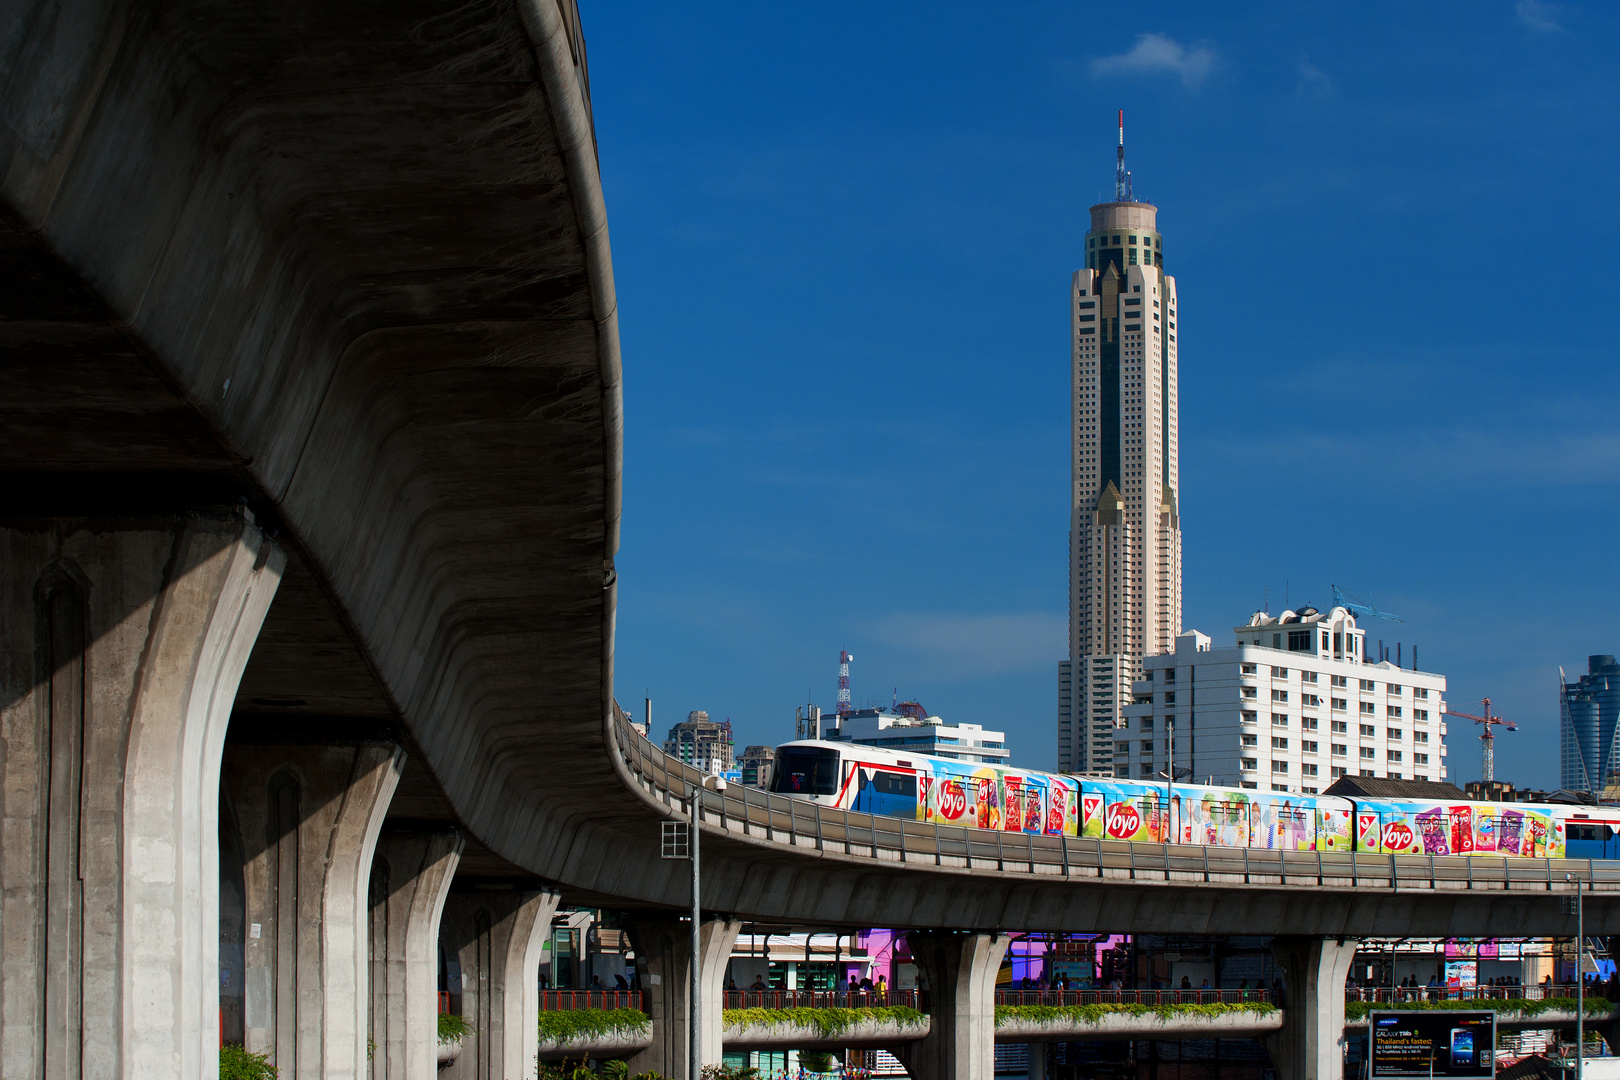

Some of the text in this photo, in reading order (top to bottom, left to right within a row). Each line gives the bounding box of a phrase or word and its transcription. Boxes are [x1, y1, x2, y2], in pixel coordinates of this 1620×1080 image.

[936, 783, 965, 817] Yoyo
[1101, 805, 1138, 837] Yoyo
[1380, 824, 1412, 849] Yoyo
